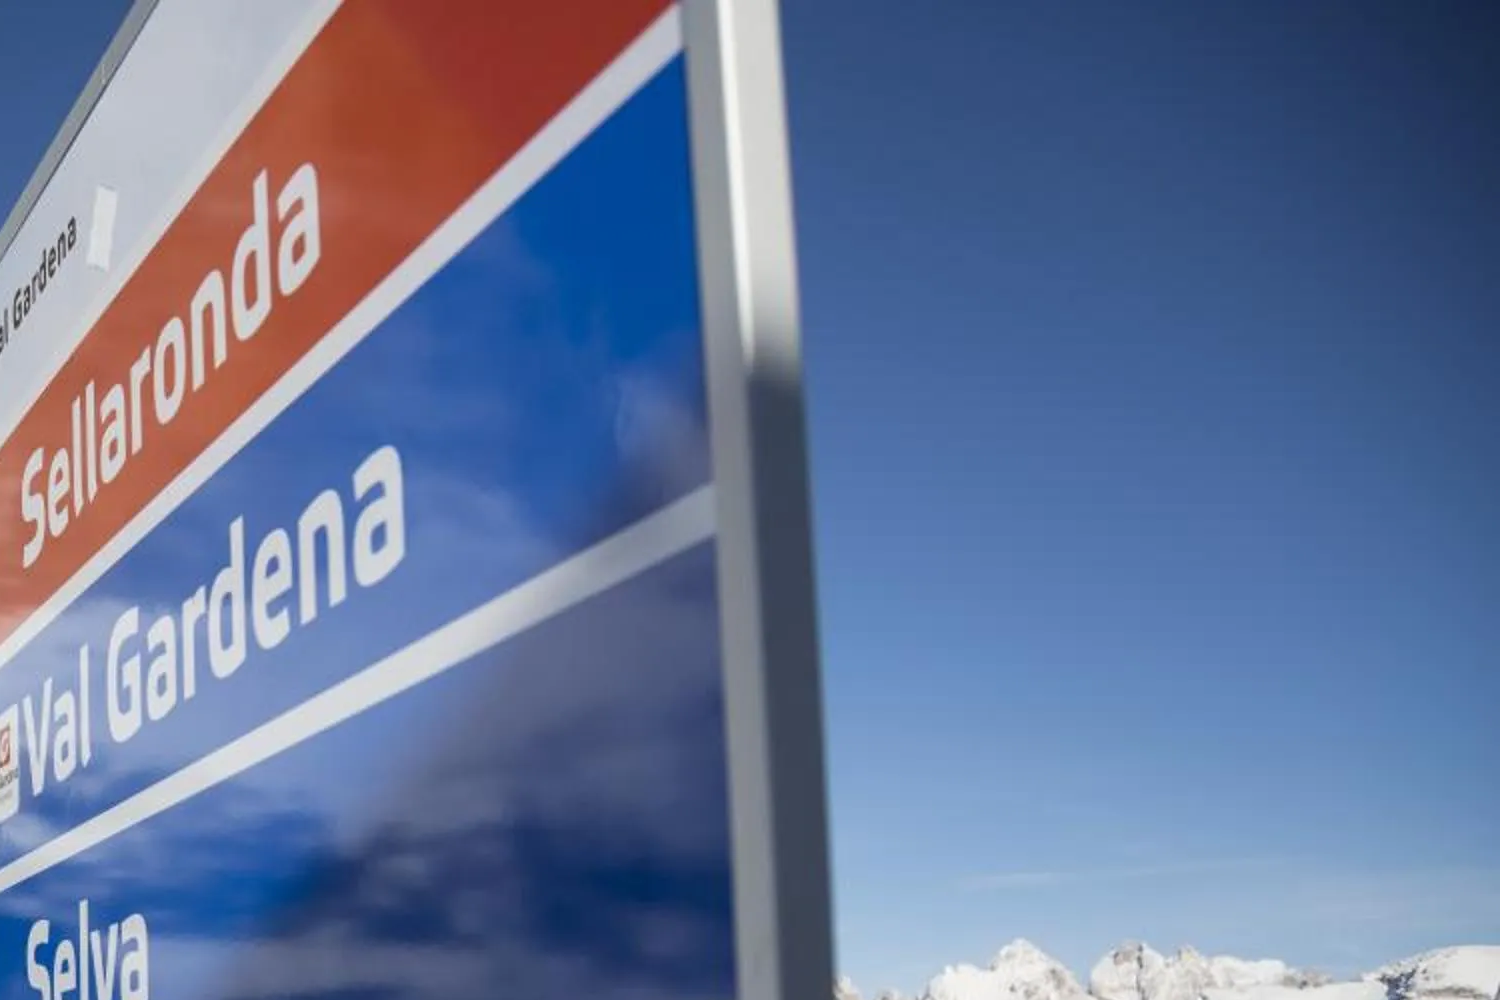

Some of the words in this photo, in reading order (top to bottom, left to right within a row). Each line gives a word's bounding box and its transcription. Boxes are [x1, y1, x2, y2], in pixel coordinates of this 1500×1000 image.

[13, 215, 77, 330] Gardena
[21, 162, 321, 568] Sellaronda
[22, 644, 92, 797] Val
[106, 445, 405, 744] Gardena
